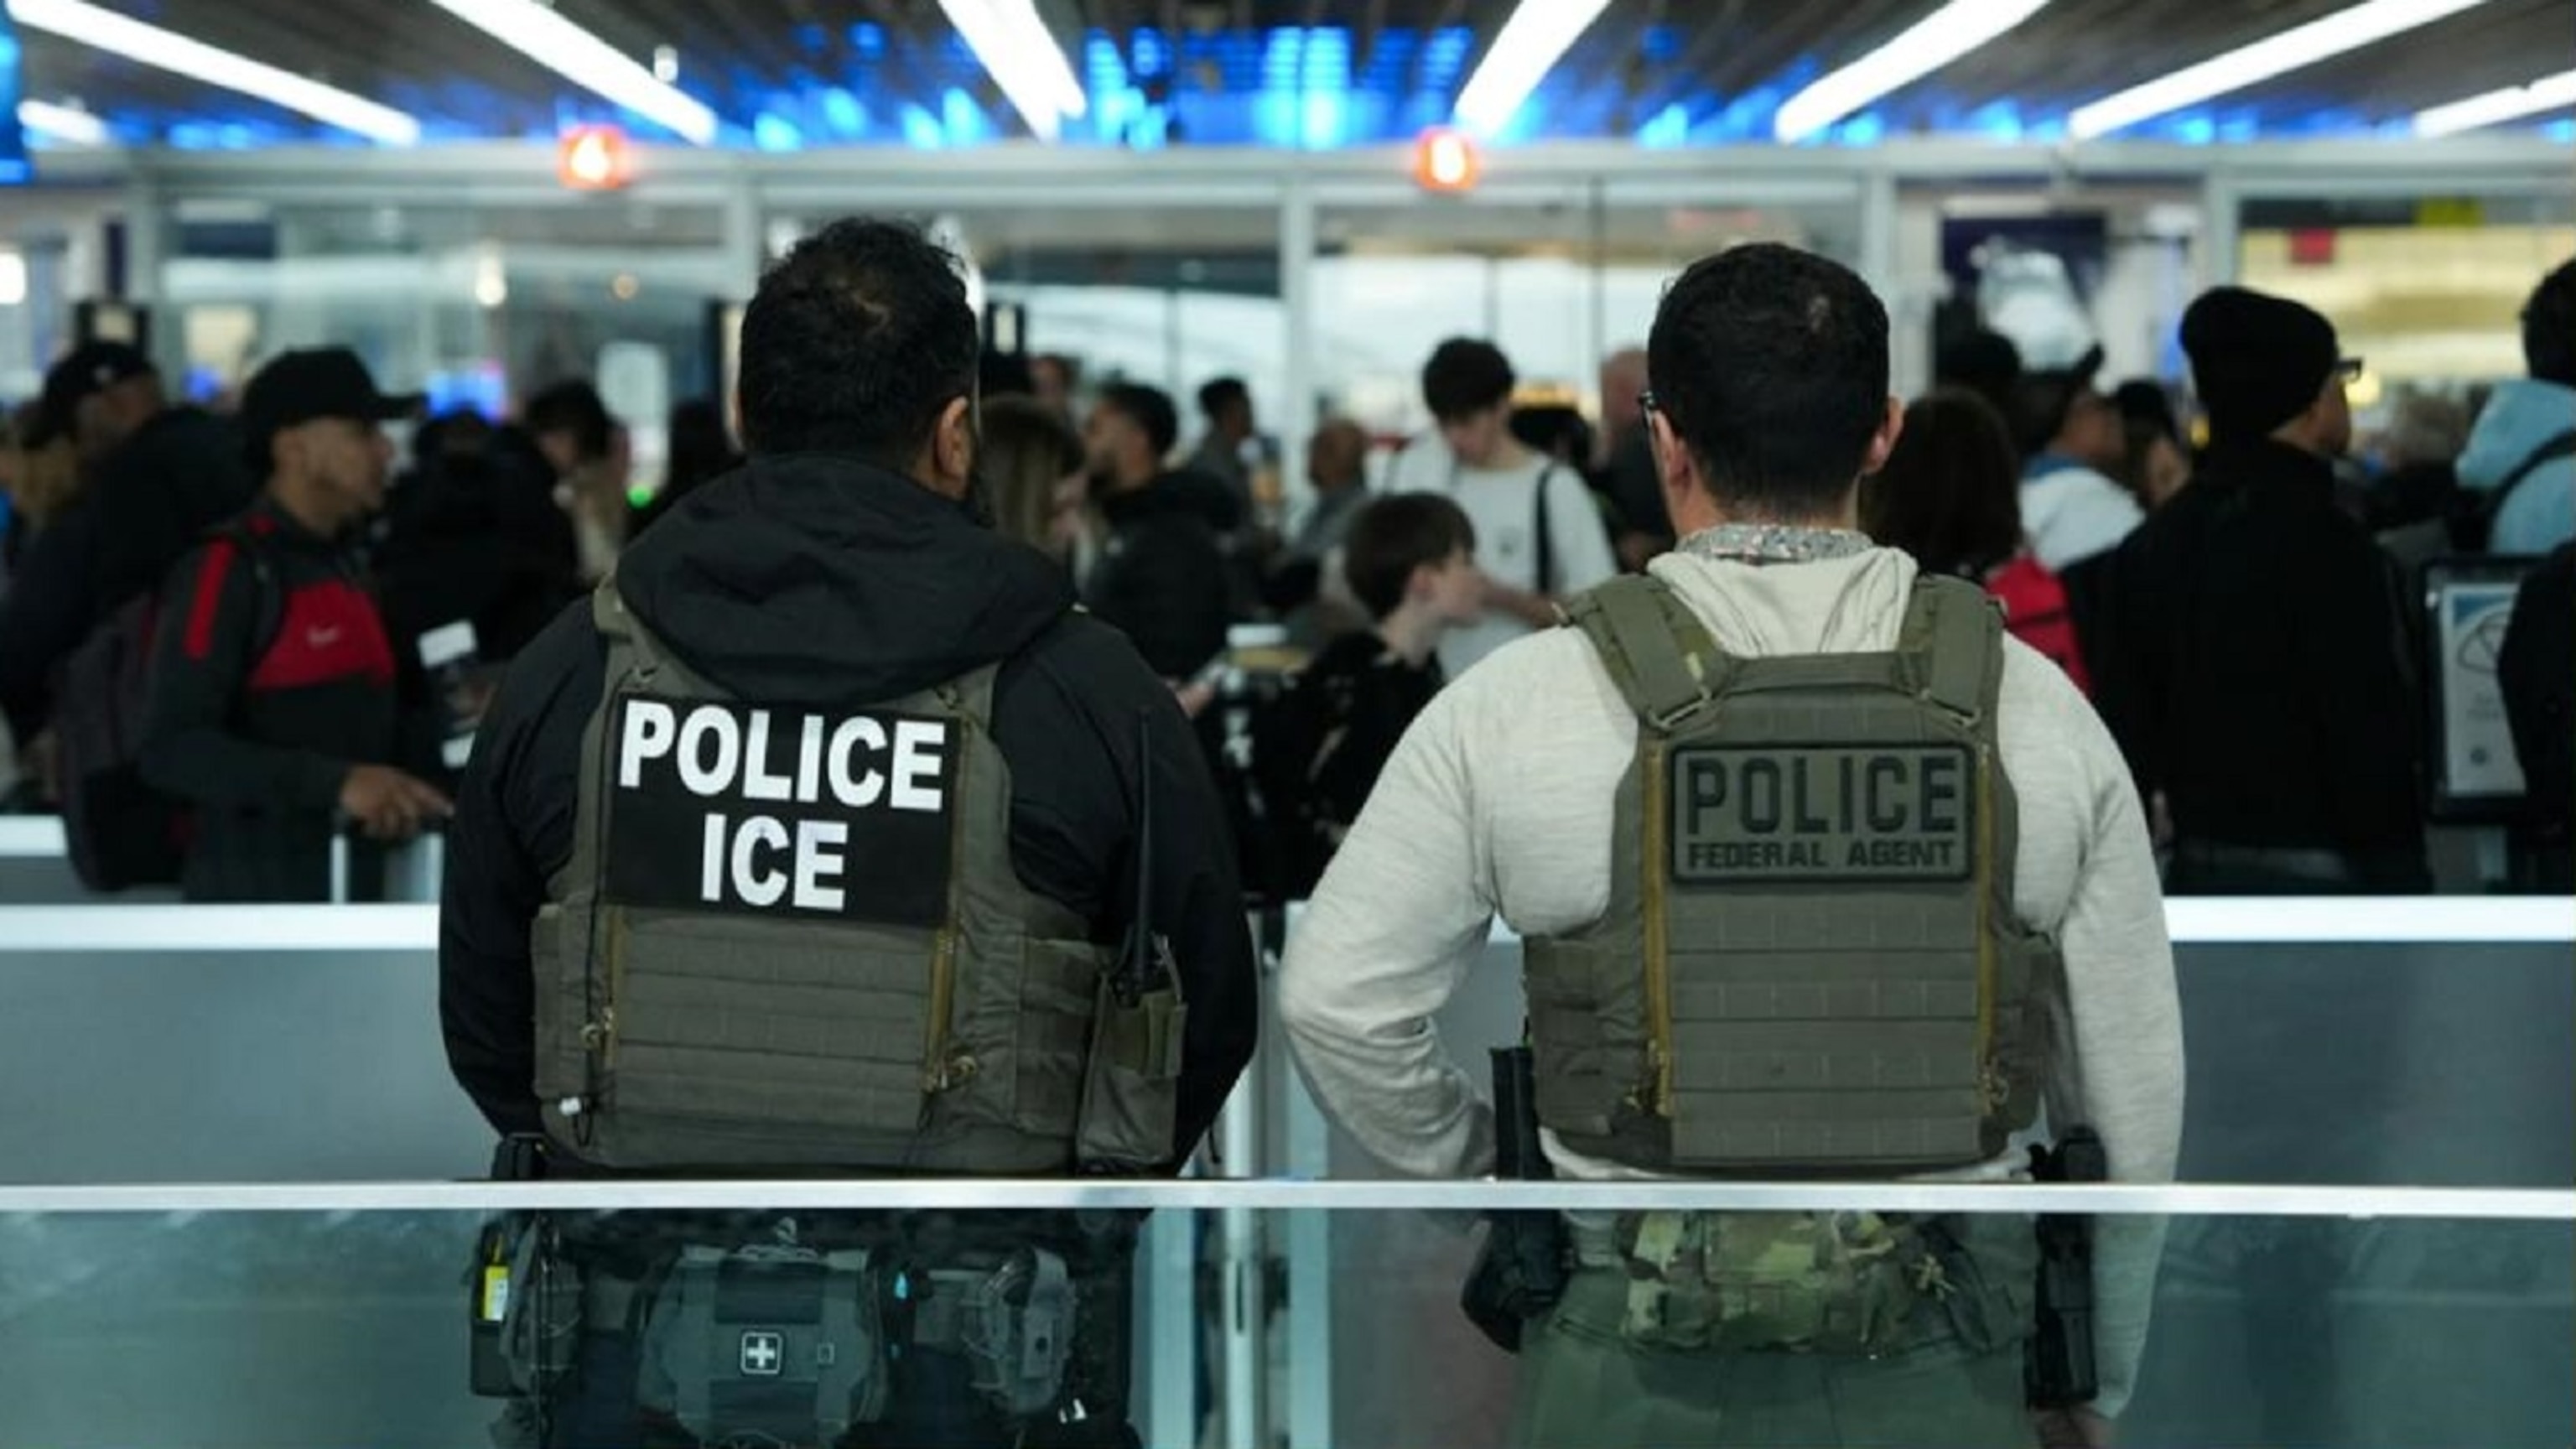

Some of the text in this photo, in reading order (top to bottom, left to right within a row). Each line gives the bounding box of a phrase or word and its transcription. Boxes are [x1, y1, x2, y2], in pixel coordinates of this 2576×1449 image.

[620, 699, 945, 811] POLICE
[1687, 756, 1957, 834] POLICE
[702, 813, 848, 910] ICE
[1688, 840, 1955, 869] FEDERAL AGENT
